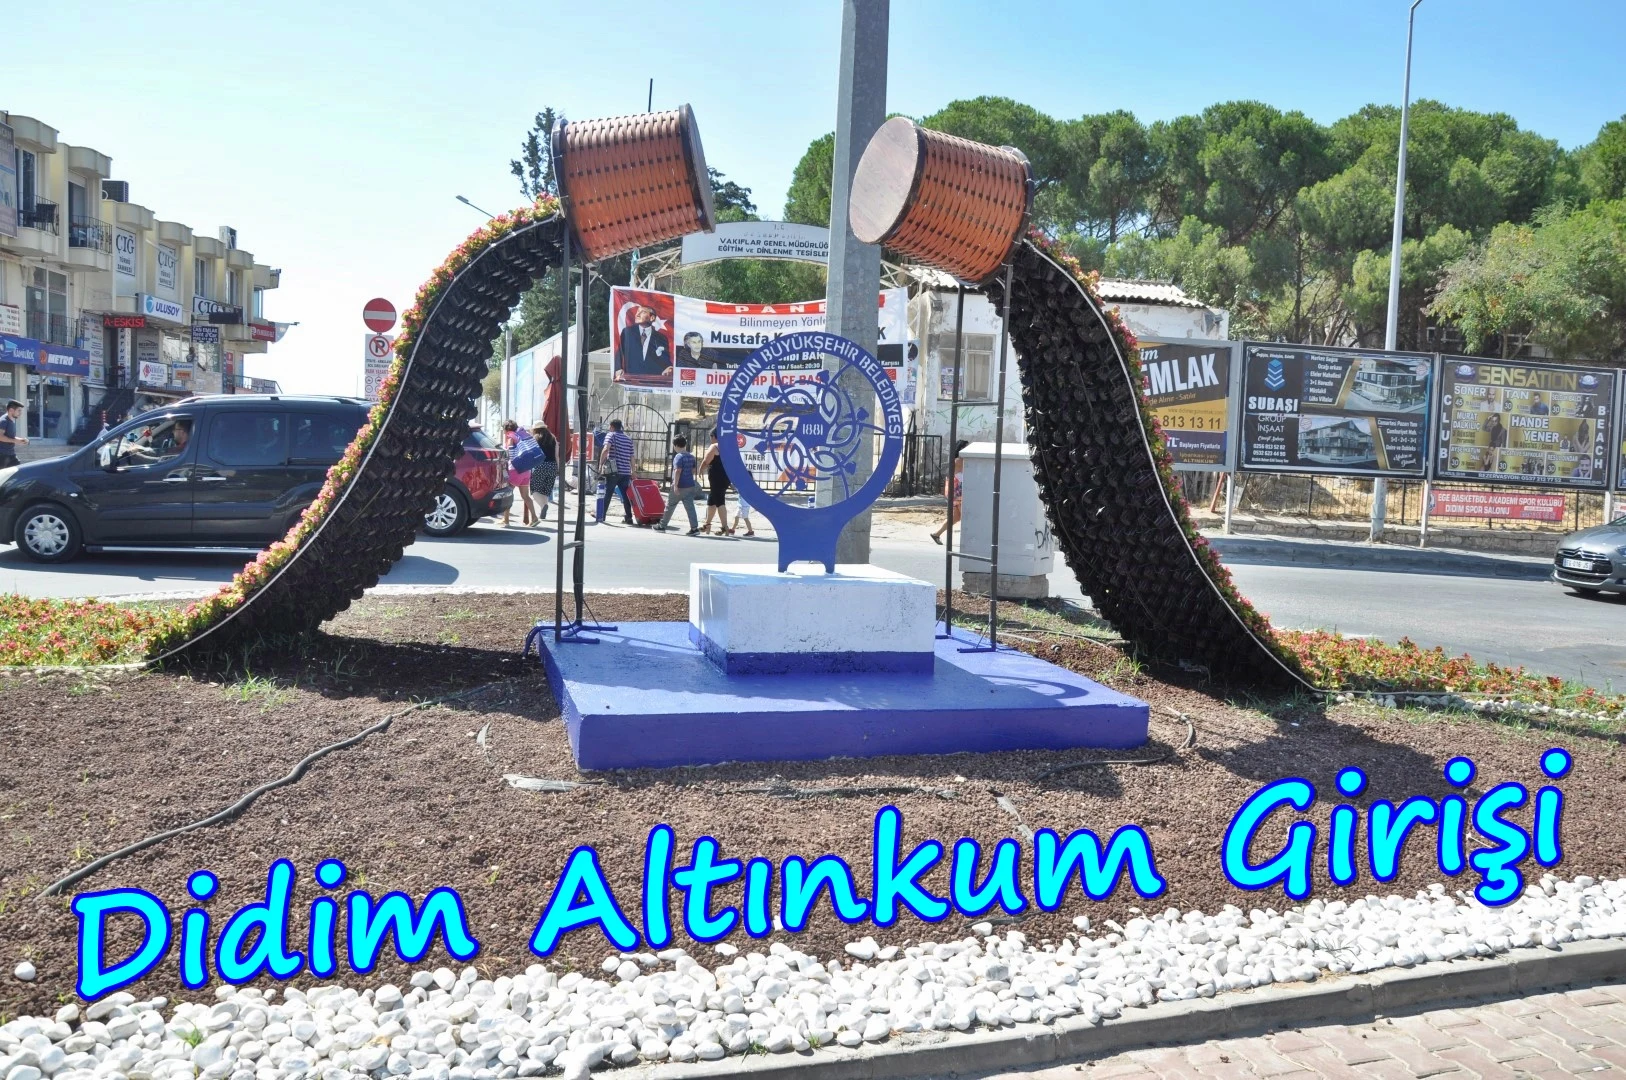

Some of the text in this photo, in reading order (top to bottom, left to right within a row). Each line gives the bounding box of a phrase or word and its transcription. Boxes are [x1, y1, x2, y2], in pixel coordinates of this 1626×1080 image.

[720, 238, 761, 246] VAKIFLAR
[788, 239, 828, 249] MÜDÜRLÜĞ
[756, 247, 793, 255] DİNLENME
[155, 301, 180, 317] ULUSOY
[735, 303, 826, 315] PANE
[739, 316, 826, 329] Bilinmeyen Yönle
[710, 331, 769, 344] Mustafa
[47, 353, 73, 366] METRO
[706, 371, 731, 385] DİDİ
[1140, 353, 1219, 396] EMLAK
[1479, 365, 1577, 391] SENSATION
[721, 334, 903, 440] T.C. AYDIN BÜYÜKŞEHİR BELEDİYESİ
[1454, 385, 1486, 396] SONER
[1505, 389, 1529, 400] TAN
[1248, 396, 1298, 413] SUBAŞI
[1552, 405, 1560, 413] 30
[1162, 415, 1185, 428] 813
[1190, 417, 1204, 429] 13
[1208, 418, 1221, 430] 11
[1258, 414, 1286, 423] GROUP
[1457, 412, 1477, 421] MURAT
[1511, 416, 1548, 429] HANDE
[803, 424, 823, 435] 1881
[1258, 423, 1284, 434] İNŞAAT
[1440, 395, 1452, 459] CLUB
[1453, 421, 1480, 431] DALKILIÇ
[1523, 430, 1559, 443] YENER
[1594, 405, 1606, 469] BEACH
[1179, 441, 1199, 449] Başlayan
[745, 463, 770, 471] ZDEMİR
[1438, 493, 1450, 502] EGE
[1451, 494, 1488, 503] BASKETBOL
[1519, 497, 1536, 506] SPOR
[1537, 497, 1562, 507] KULÜBÜ
[1466, 505, 1482, 514] SPOR
[1484, 506, 1510, 515] SALONU
